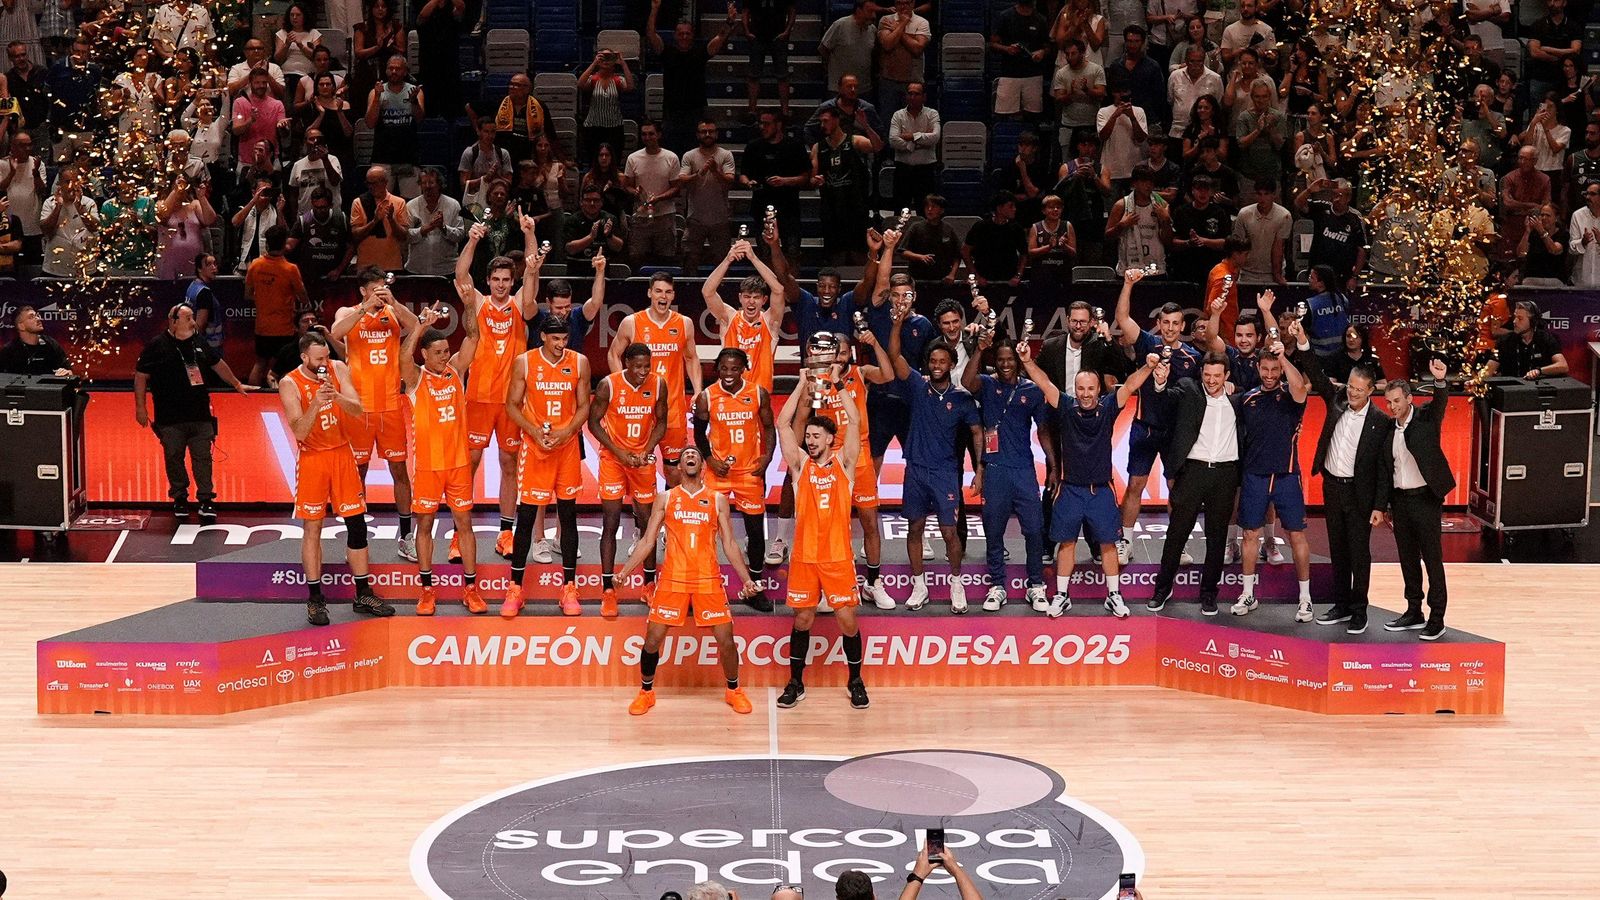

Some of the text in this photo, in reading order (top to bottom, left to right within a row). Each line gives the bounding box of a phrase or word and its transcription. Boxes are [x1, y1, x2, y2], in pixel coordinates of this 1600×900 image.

[830, 156, 841, 167] 15
[1322, 226, 1348, 243] bwin
[38, 310, 77, 321] LOTUS
[359, 328, 393, 339] VALENCIA
[496, 340, 505, 355] 3
[370, 349, 388, 365] 65
[656, 360, 667, 376] 4
[536, 381, 573, 391] VALENCIA
[437, 405, 456, 423] 32
[547, 400, 562, 417] 12
[617, 405, 652, 415] VALENCIA
[716, 411, 753, 421] VALENCIA
[320, 412, 338, 431] 24
[835, 409, 850, 426] 13
[627, 423, 641, 438] 10
[729, 428, 745, 444] 18
[820, 493, 830, 509] 2
[673, 510, 709, 522] VALENCIA
[690, 532, 696, 549] 1
[407, 626, 613, 667] CAMPEÓN
[862, 635, 1020, 667] ENDESA
[1028, 634, 1131, 667] 2025
[56, 660, 87, 669] Wilson
[176, 659, 200, 668] renfe
[303, 663, 346, 679] mediolanum
[354, 657, 379, 670] pelayo
[1161, 656, 1210, 674] endesa
[1342, 661, 1372, 670] Wilson
[1459, 660, 1484, 668] renfe
[183, 679, 201, 687] UAX
[1245, 669, 1289, 684] mediolanum
[1296, 678, 1323, 690] pelayo
[1466, 679, 1485, 687] UAX
[217, 676, 267, 693] endesa
[493, 828, 1053, 854] supercopa
[540, 850, 1060, 885] endesa
